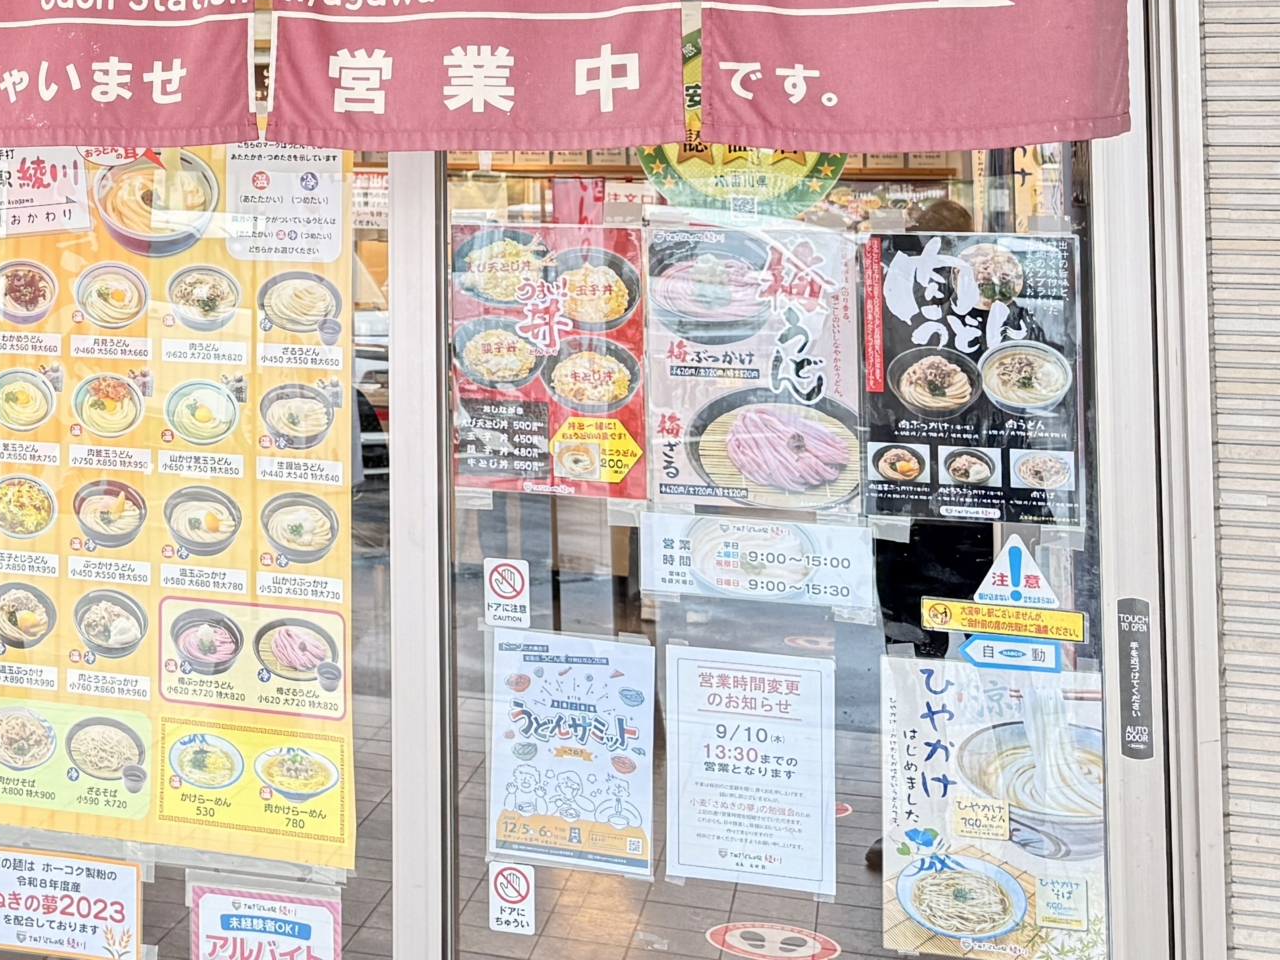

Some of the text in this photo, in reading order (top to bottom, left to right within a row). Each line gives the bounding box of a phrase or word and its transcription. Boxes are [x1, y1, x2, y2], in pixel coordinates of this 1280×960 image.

[328, 46, 640, 114] 営業中
[721, 61, 838, 108] です。
[16, 155, 78, 189] 綾川
[11, 209, 72, 225] おかわり
[576, 284, 613, 296] 玉子丼
[883, 237, 1027, 353] 肉うどん
[519, 299, 570, 348] 丼
[2, 334, 43, 344] わかめうどん
[93, 339, 129, 347] 月見うどん
[189, 343, 219, 352] 肉うどん
[282, 347, 319, 356] ざるうどん
[481, 342, 517, 354] 親子丼
[667, 340, 755, 365] 梅ぶっかけ
[571, 370, 613, 381] 牛とじ丼
[483, 405, 524, 415] おしながき
[1005, 419, 1045, 430] 肉うどん
[657, 412, 684, 478] 梅ざる
[601, 449, 637, 458] ミニうどん
[600, 459, 629, 469] 200円
[662, 538, 691, 551] 営業
[723, 541, 739, 549] 平日
[83, 560, 135, 572] ぶっかけうどん
[662, 554, 692, 567] 時間
[180, 568, 227, 579] 温玉ぶっかけ
[163, 577, 243, 590] 小580 大680 特大780
[272, 576, 328, 589] 山かけぶっかけ
[716, 578, 739, 587] 日曜日
[259, 585, 340, 600] 小530 大630 特大730
[487, 602, 527, 613] ドアに注意
[960, 606, 1044, 623] 大変申し訳ございませんが、
[1119, 614, 1148, 623] TOUCH
[1121, 623, 1147, 632] TO OPEN
[3, 675, 24, 684] 大890
[27, 677, 54, 688] 特大990
[79, 674, 138, 687] 肉とろろぶっかけ
[178, 677, 234, 690] 梅ぶっかけうどん
[698, 672, 801, 696] 営業時間変更
[1130, 642, 1141, 717] 手を近づけてください
[276, 687, 319, 698] 梅ざるうどん
[707, 693, 792, 714] のお知らせ
[509, 699, 639, 750] うどんサミット
[1126, 726, 1148, 734] AUTO
[716, 724, 768, 743] 9/10
[920, 668, 957, 798] ひやかけ
[1126, 734, 1148, 742] DOOR
[703, 761, 795, 779] 営業となります
[903, 729, 920, 823] はじめました
[2, 786, 23, 796] 大800
[26, 789, 55, 800] 特大900
[87, 787, 117, 798] ざるそば
[180, 792, 231, 808] かけらーめん
[196, 806, 215, 817] 530
[264, 803, 326, 819] 肉かけらーめん
[956, 801, 1005, 813] ひやかけ
[285, 817, 305, 829] 780
[984, 813, 1005, 823] うどん
[42, 863, 117, 881] ホーコク製粉の
[16, 876, 81, 892] 令和8年度産
[1039, 878, 1081, 889] ひやかけ
[499, 906, 526, 917] ドアに
[3, 915, 99, 935] を配合しております
[229, 917, 299, 935] 未経験者OK!
[495, 917, 530, 928] ちゅうい
[206, 935, 322, 960] アルバイト
